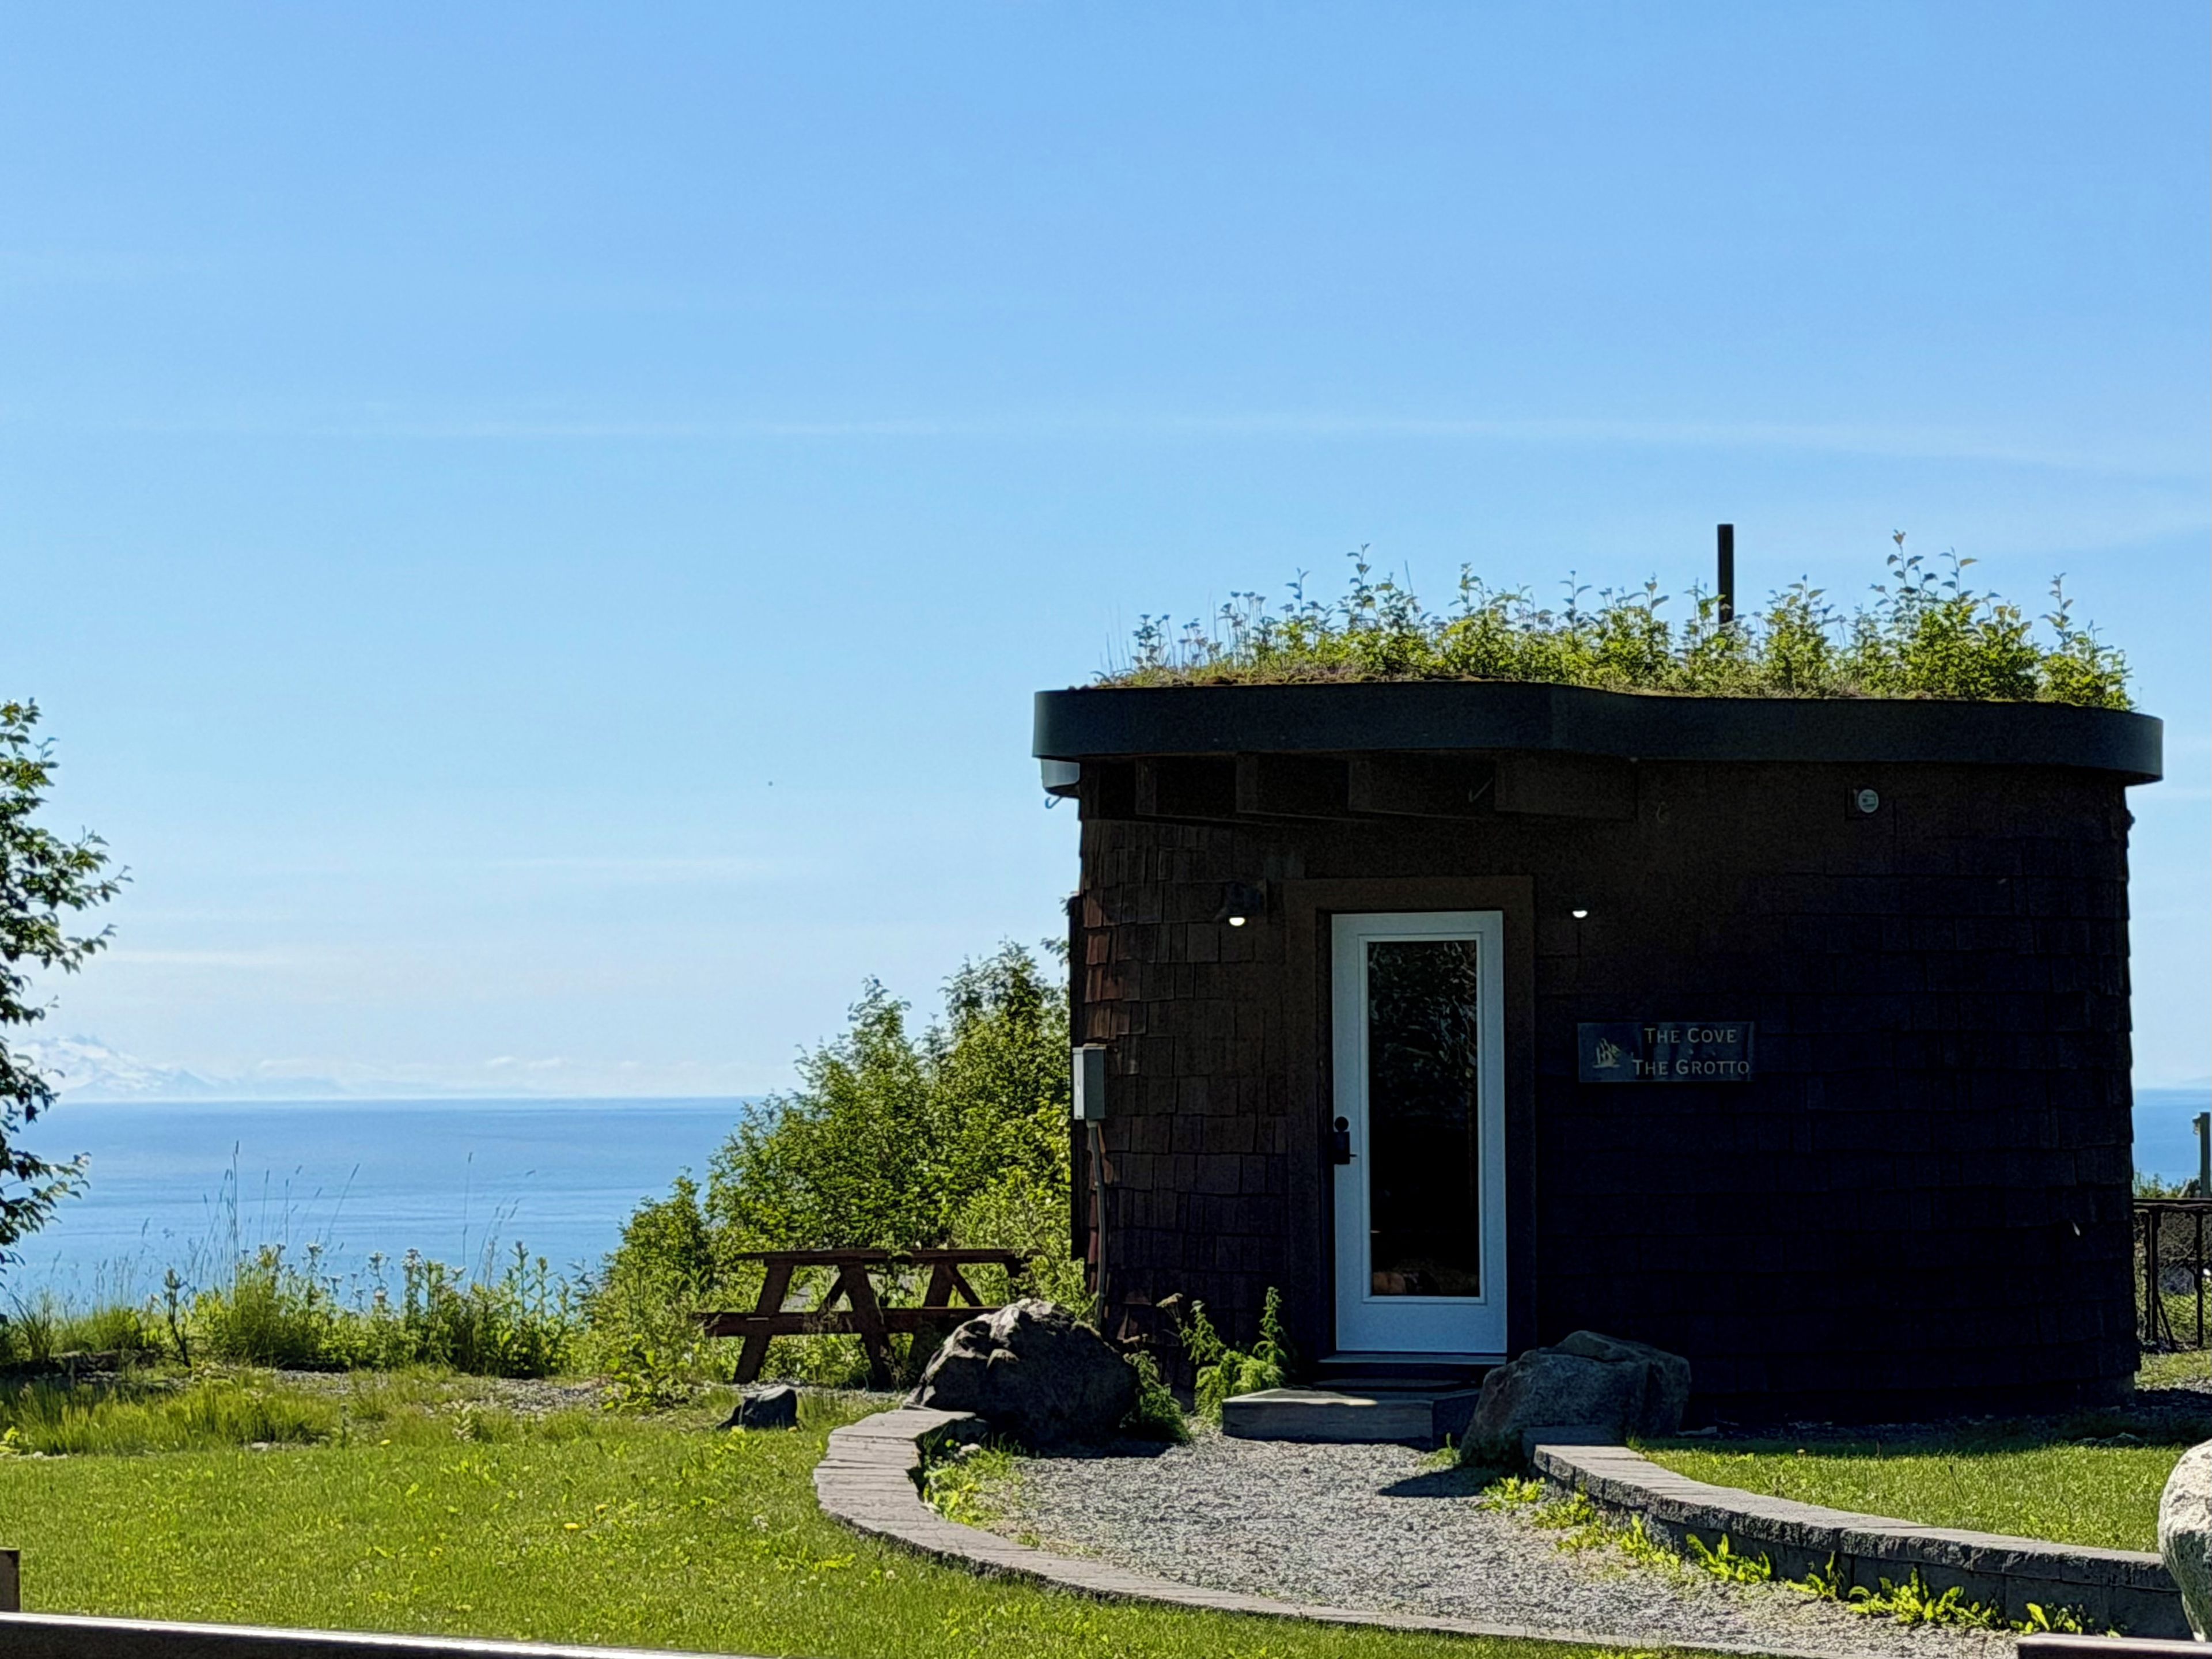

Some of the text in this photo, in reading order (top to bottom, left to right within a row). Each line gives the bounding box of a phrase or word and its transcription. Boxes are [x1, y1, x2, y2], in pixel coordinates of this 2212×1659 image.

[1644, 1028, 1737, 1043] THE COVE
[1632, 1059, 1750, 1075] THE GROTTO
